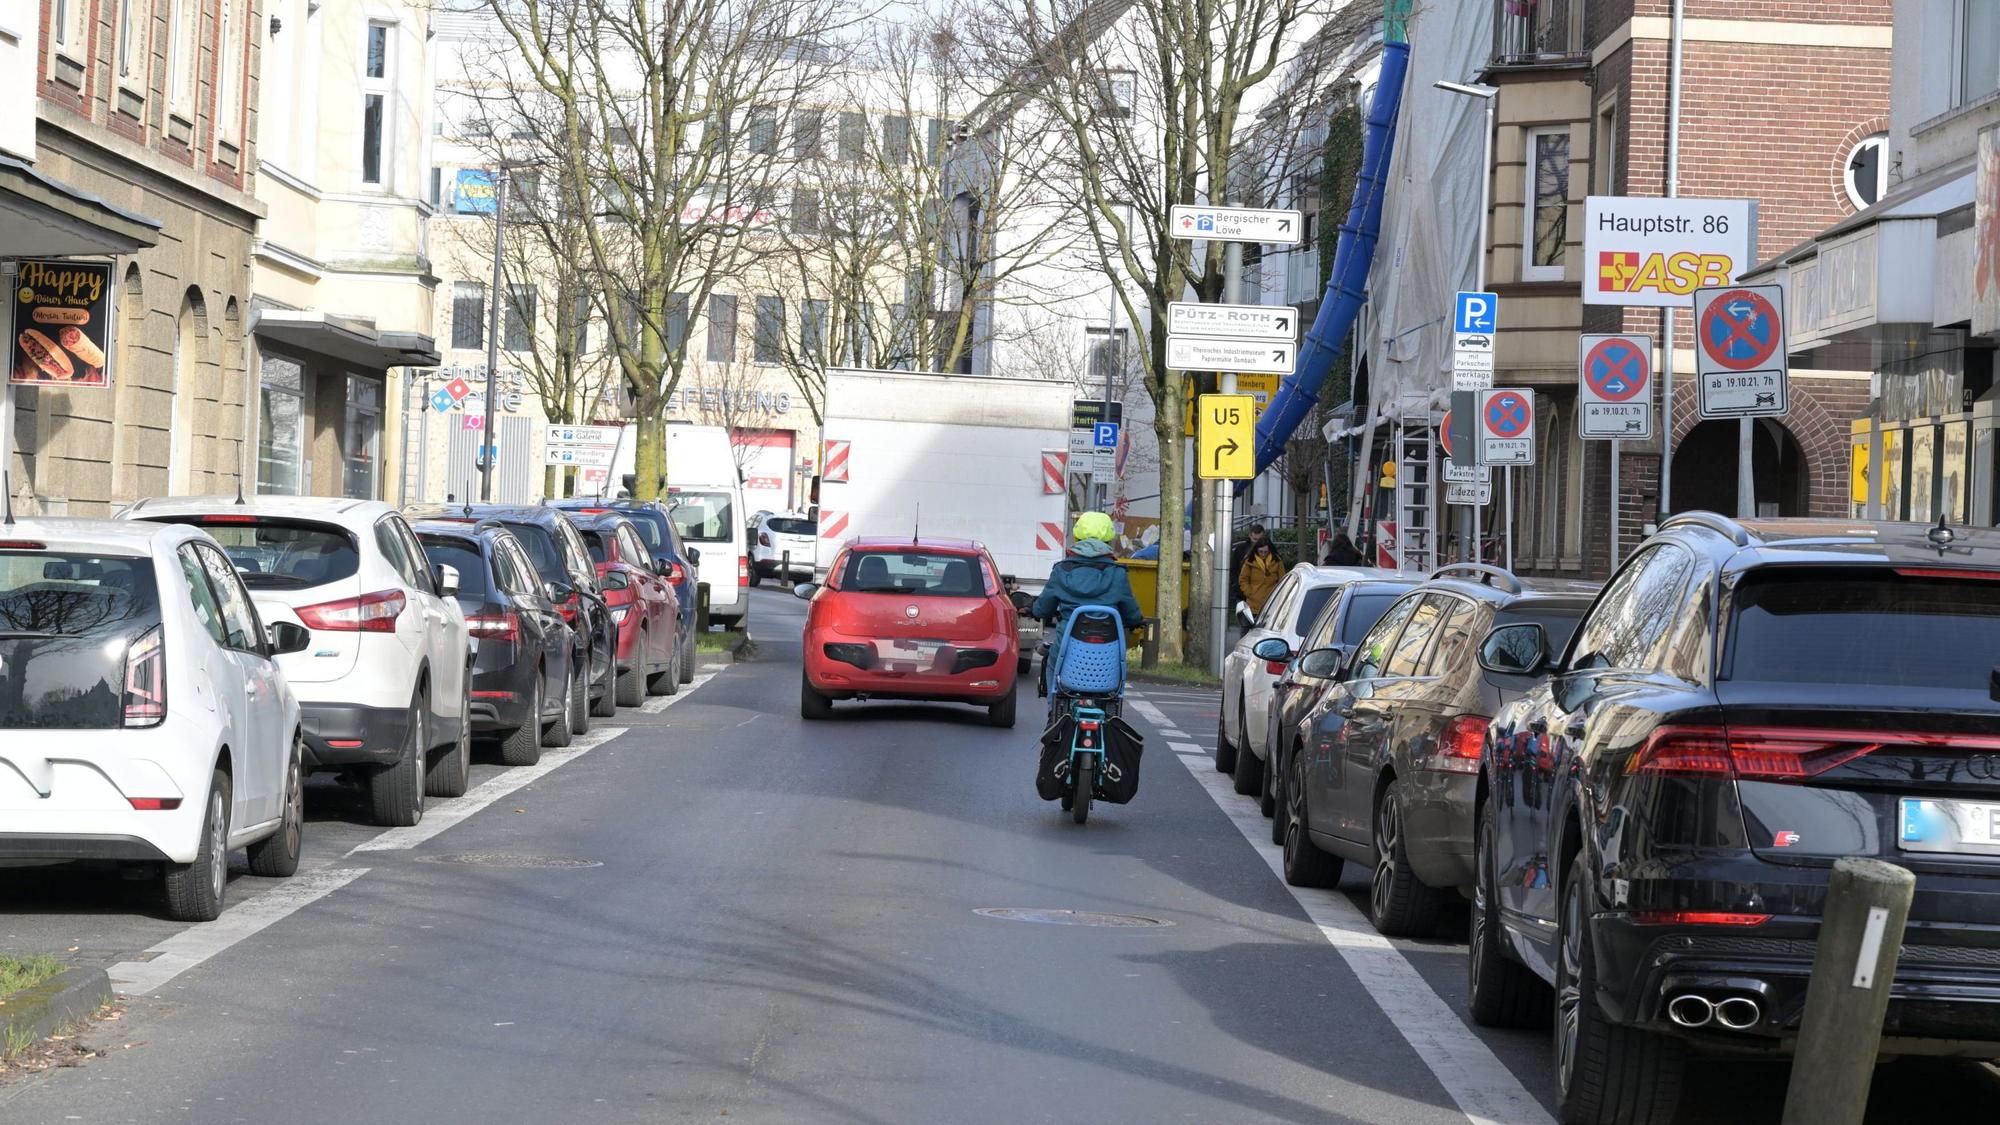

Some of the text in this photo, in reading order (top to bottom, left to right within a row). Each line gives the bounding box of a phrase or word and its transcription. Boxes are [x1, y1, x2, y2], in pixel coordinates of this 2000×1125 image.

[1216, 213, 1270, 224] Bergischer
[1216, 225, 1242, 235] Löwe
[1599, 212, 1729, 237] Hauptstr. 86
[1628, 251, 1733, 295] ASB
[20, 261, 104, 301] Happy
[65, 295, 89, 305] Haus
[1464, 297, 1487, 328] P
[1456, 359, 1490, 367] Parkschein
[1455, 371, 1490, 379] werktags
[1712, 375, 1774, 388] ab 19.10.21. 7h
[1214, 407, 1240, 425] U5
[1602, 407, 1629, 416] 19.10.21.
[1632, 407, 1641, 415] 7h
[1450, 486, 1485, 497] Ladezoe
